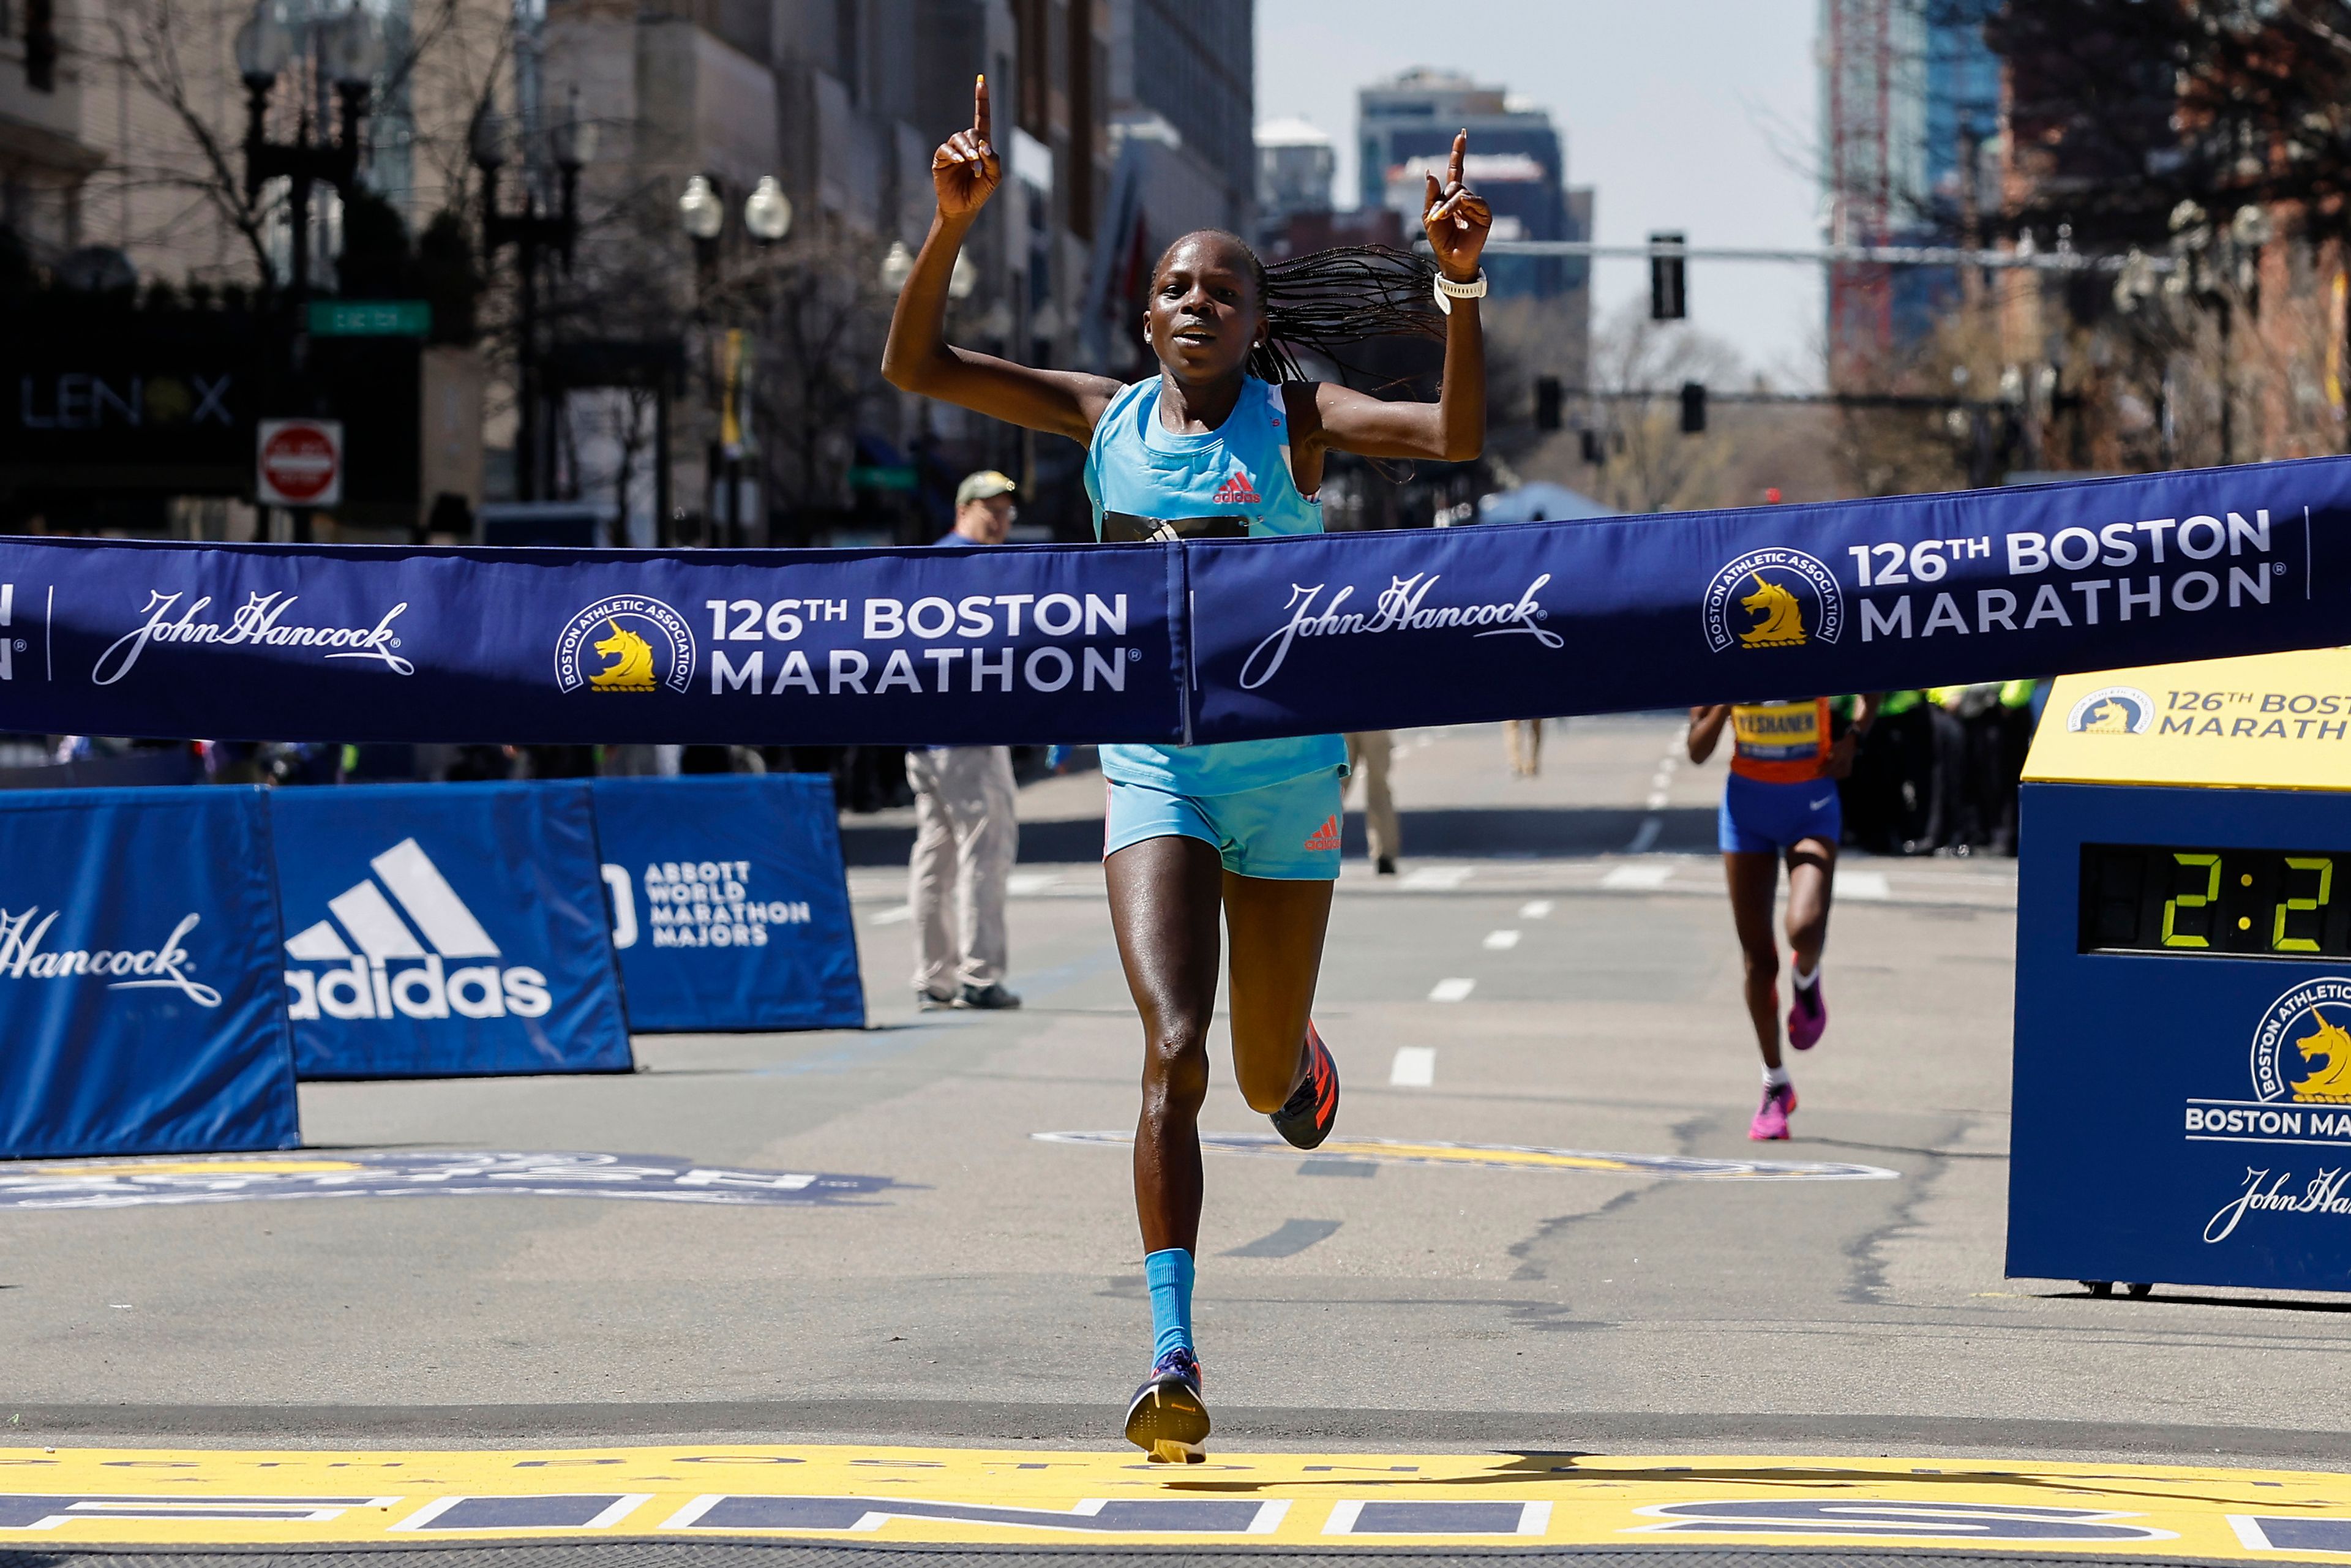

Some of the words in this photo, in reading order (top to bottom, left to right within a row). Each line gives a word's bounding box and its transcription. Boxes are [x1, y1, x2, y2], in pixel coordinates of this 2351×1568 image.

[1212, 491, 1261, 503] adidas
[1849, 535, 1990, 587] 126TH
[2006, 509, 2271, 576] BOSTON
[706, 598, 848, 641] 126TH
[864, 593, 1127, 640] BOSTON
[1709, 585, 1727, 645] BOSTON
[1723, 553, 1787, 585] ATHLETIC
[1788, 556, 1837, 637] ASSOCIATION
[92, 590, 221, 685] John
[561, 628, 581, 686] BOSTON
[579, 601, 644, 629] ATHLETIC
[645, 606, 689, 686] ASSOCIATION
[1239, 583, 1364, 689] John
[2168, 691, 2254, 711] 126TH
[2260, 693, 2351, 715] BOS
[644, 861, 751, 883] ABBOTT
[646, 880, 746, 905] WORLD
[650, 901, 811, 925] MARATHON
[653, 924, 768, 948] MAJORS
[2259, 1019, 2282, 1094] BOSTON
[2185, 1108, 2301, 1135] BOSTON
[2203, 1166, 2297, 1244] John
[515, 1455, 1419, 1472] BOSTON
[0, 1491, 2351, 1554] FINIS
